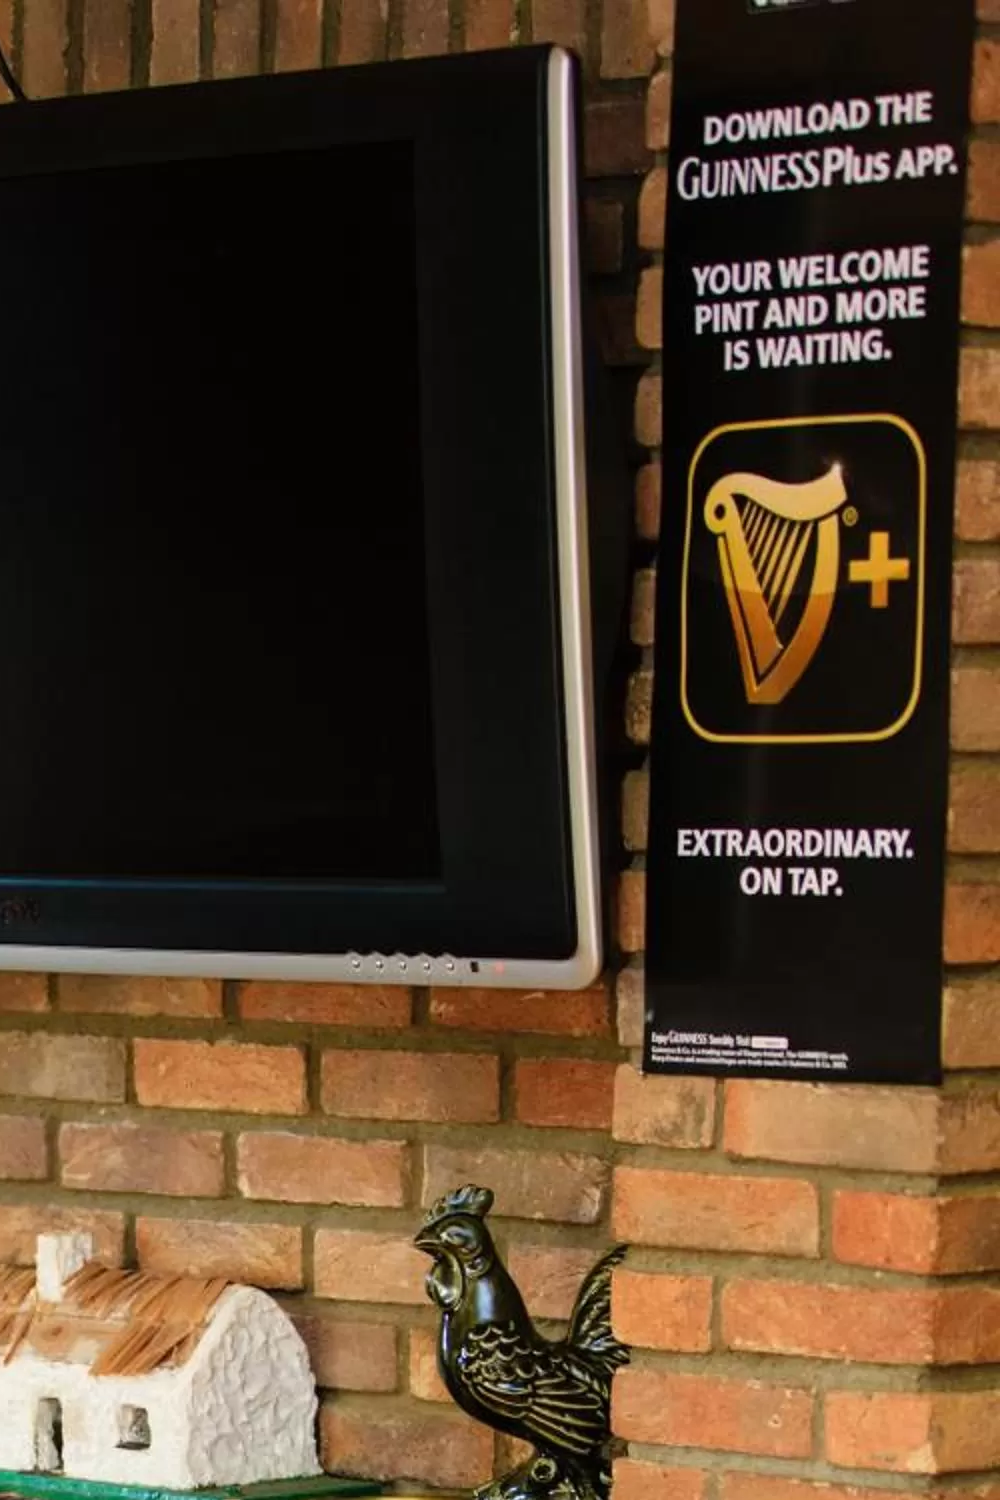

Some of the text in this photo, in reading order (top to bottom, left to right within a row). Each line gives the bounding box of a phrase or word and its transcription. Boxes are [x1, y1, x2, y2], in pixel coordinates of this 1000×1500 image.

[704, 92, 932, 144] DOWNLOAD THE
[678, 144, 957, 200] GUINNESS Plus APP.
[692, 246, 929, 296] YOUR WELCOME
[696, 286, 925, 334] PINT AND MORE
[725, 329, 892, 371] IS WAITING.
[678, 829, 913, 858] EXTRAORDINARY.
[740, 867, 843, 896] ON TAP.
